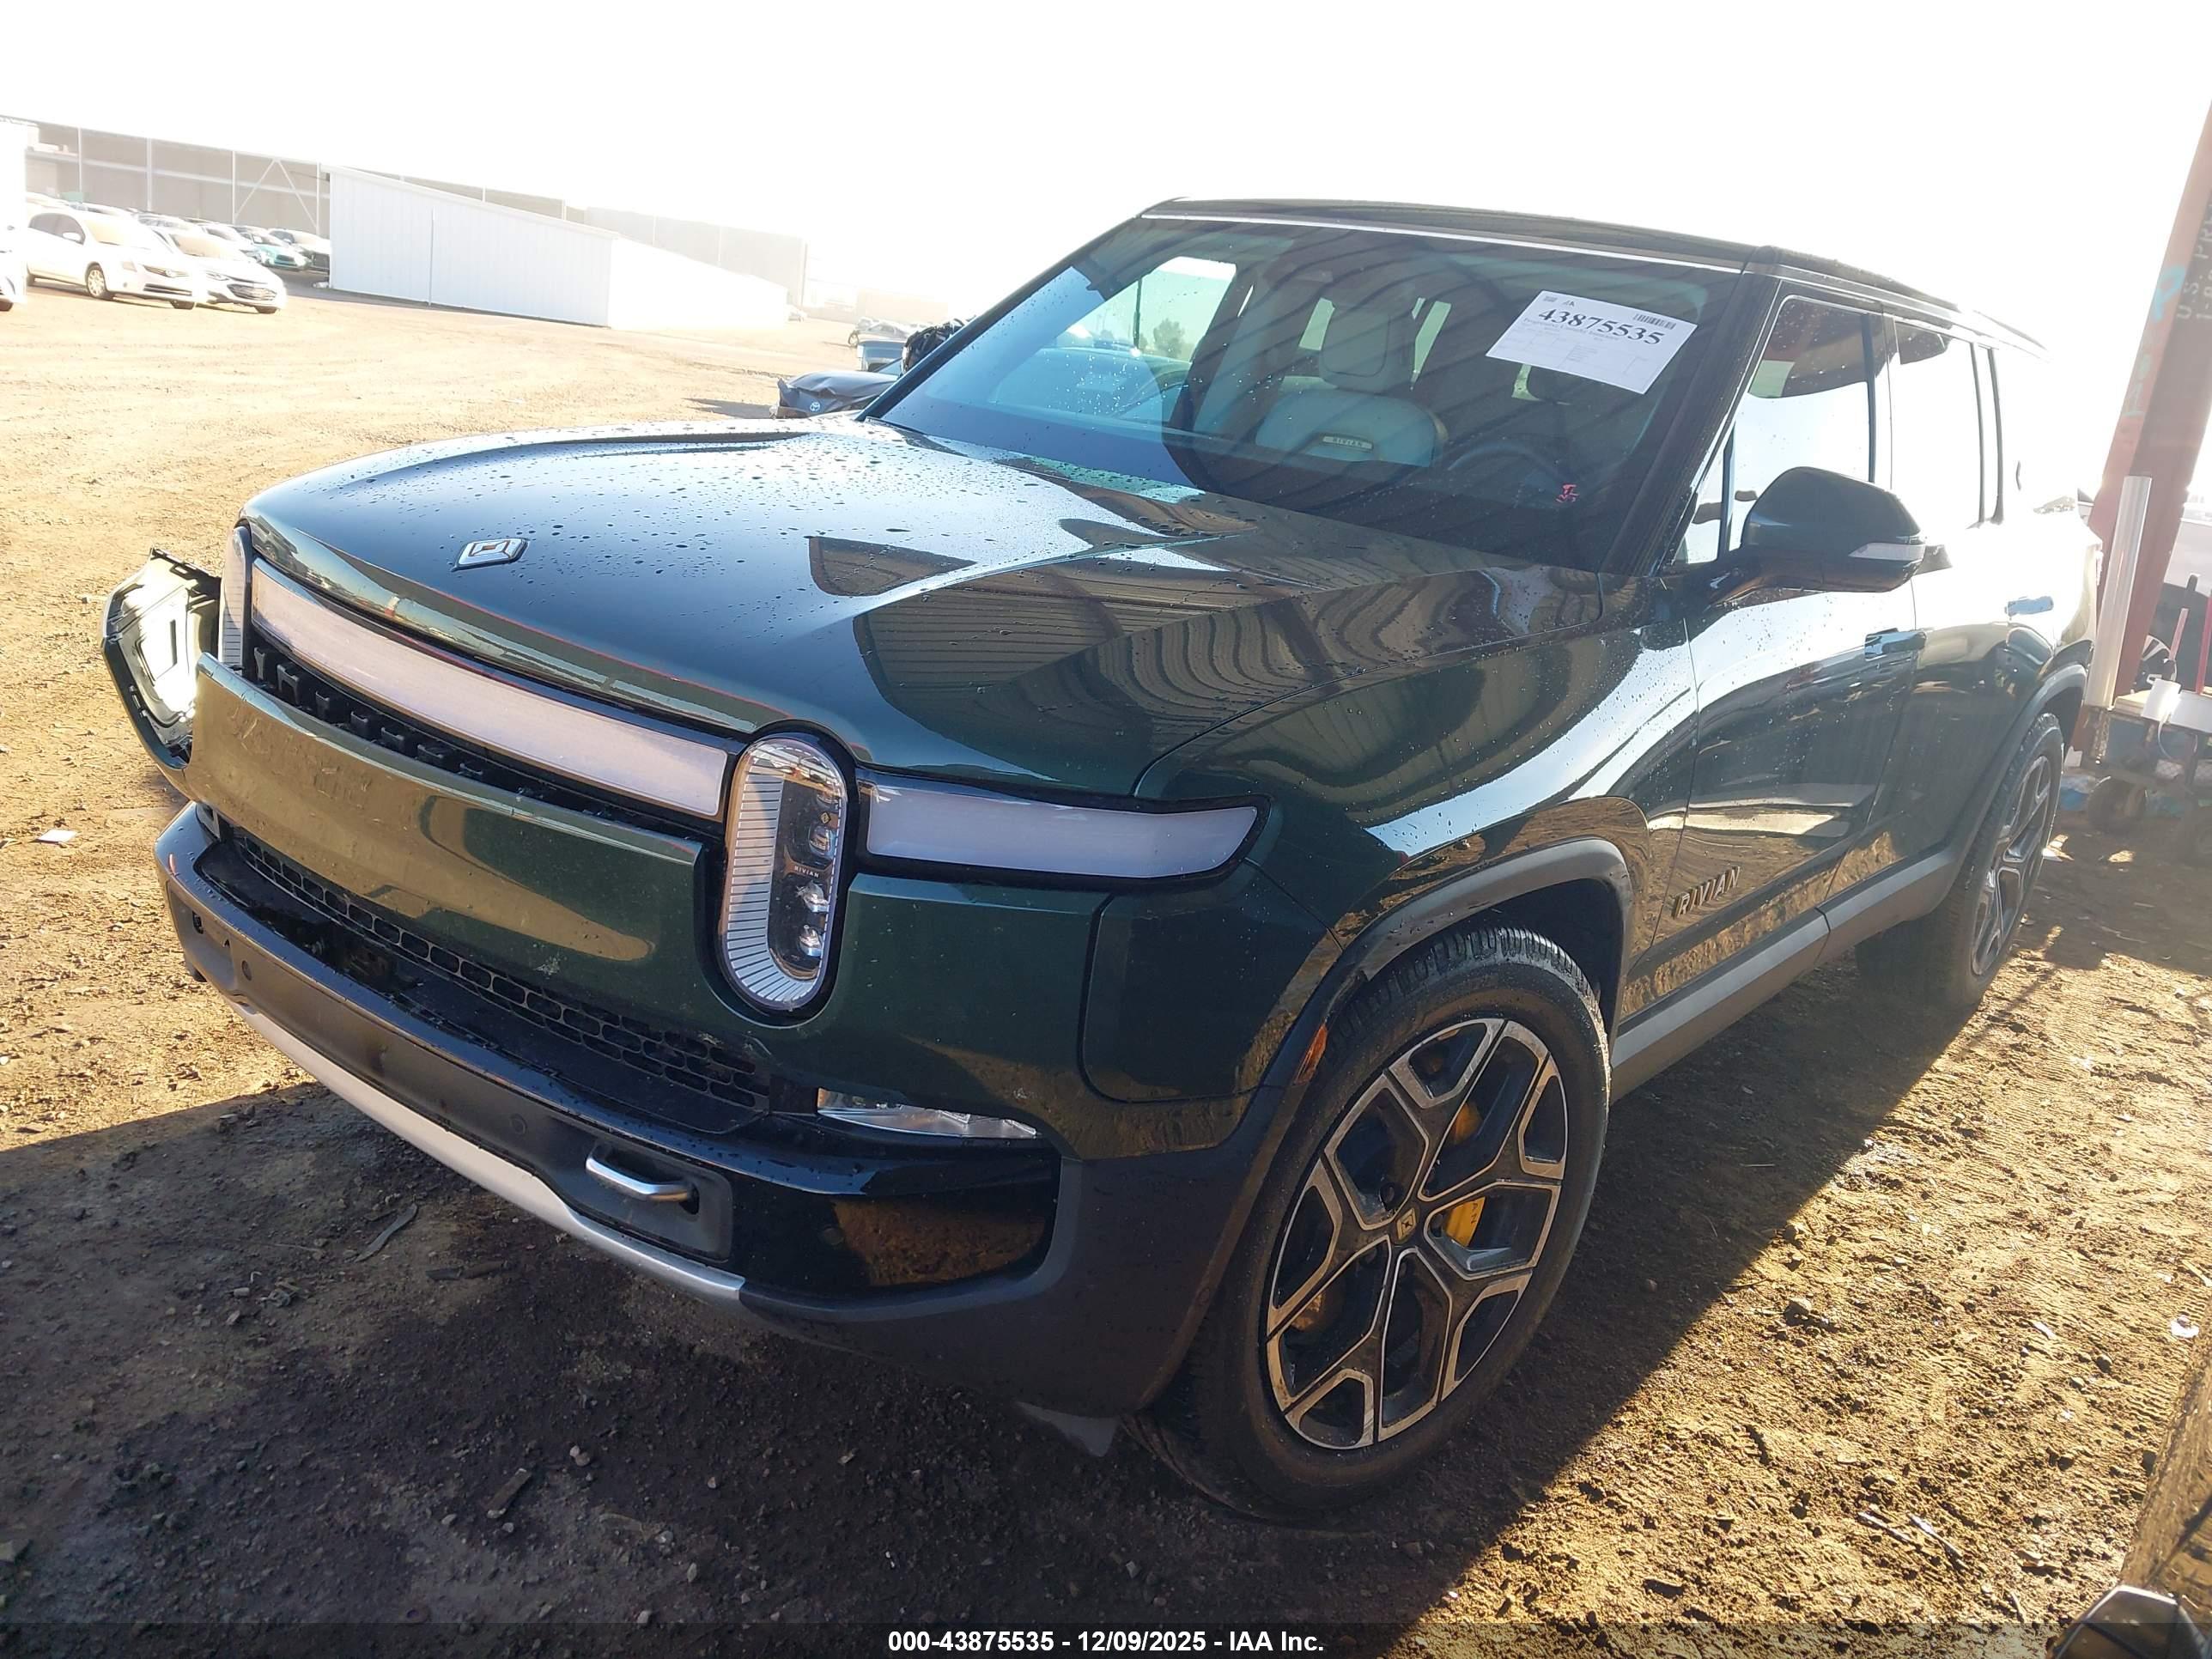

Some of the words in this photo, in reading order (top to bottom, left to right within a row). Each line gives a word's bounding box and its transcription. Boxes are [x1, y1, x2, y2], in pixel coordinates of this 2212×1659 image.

[1537, 308, 1666, 344] 43875535
[794, 865, 819, 878] RIVIAN
[1675, 866, 1741, 917] RIVIAN
